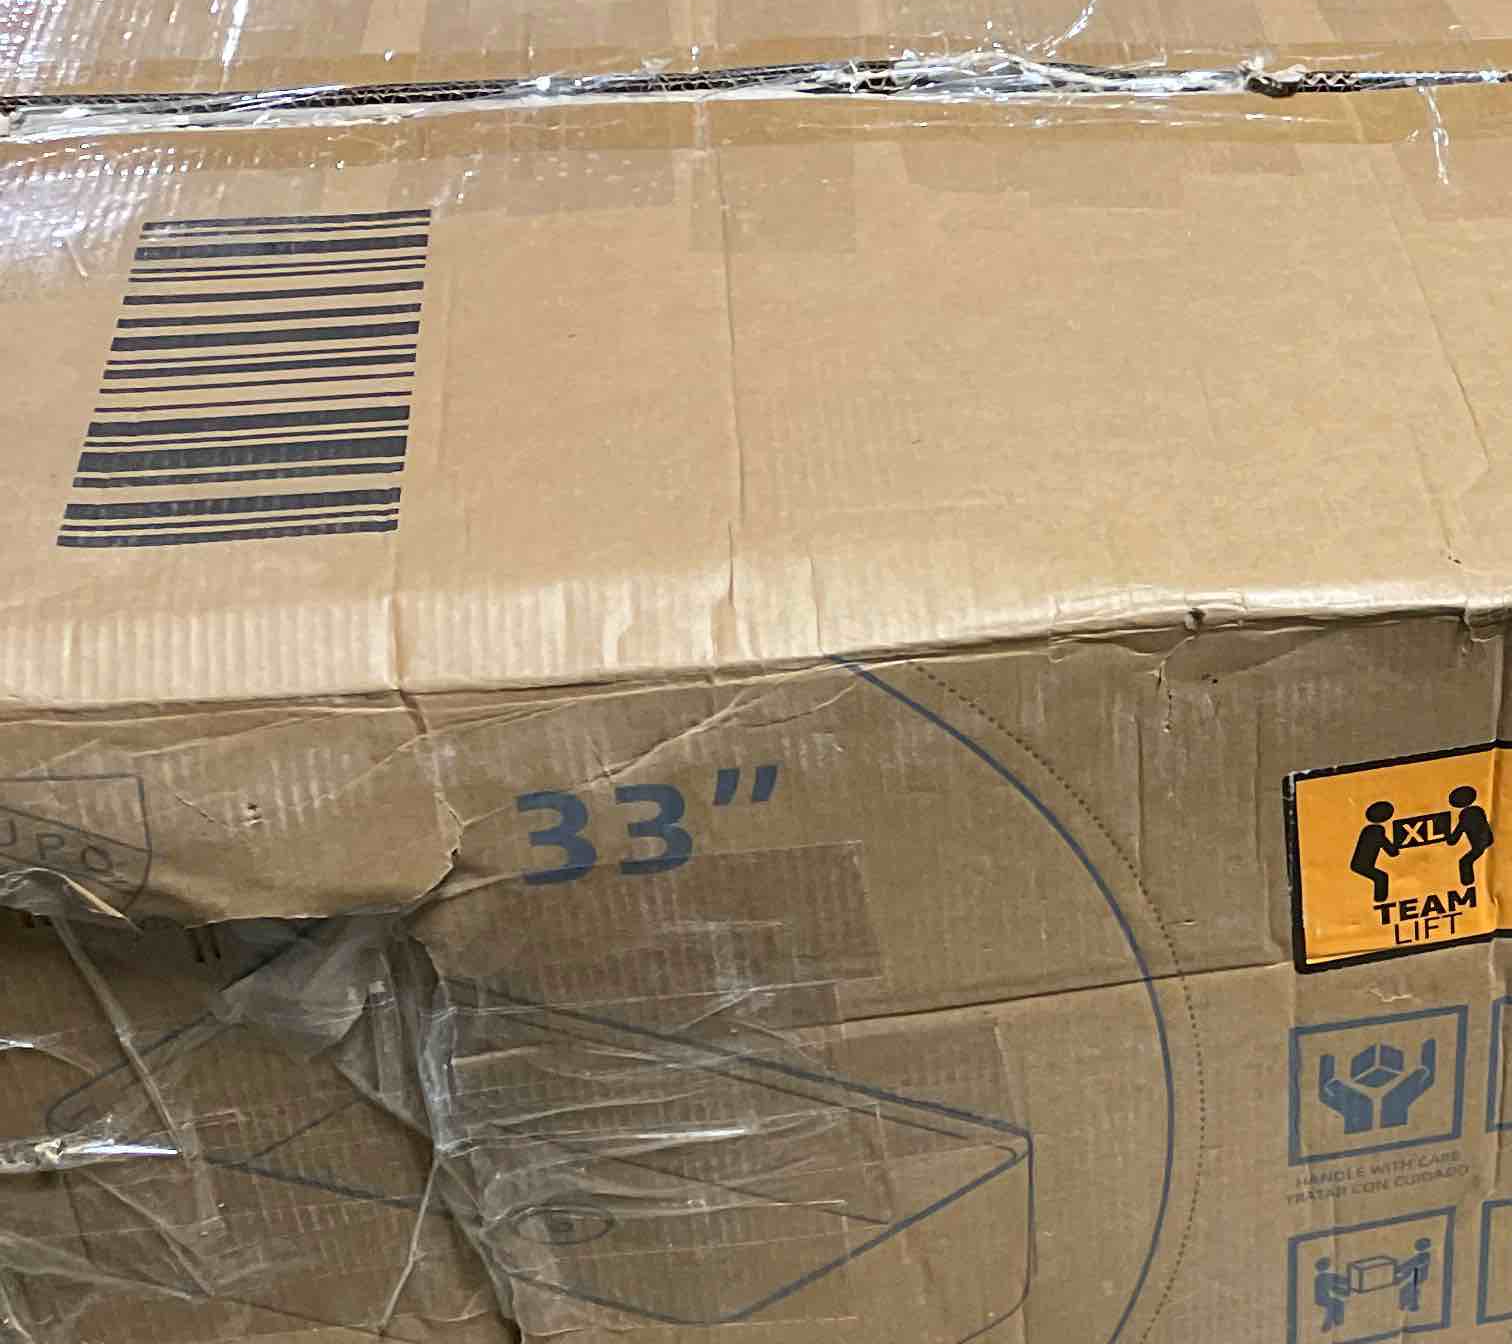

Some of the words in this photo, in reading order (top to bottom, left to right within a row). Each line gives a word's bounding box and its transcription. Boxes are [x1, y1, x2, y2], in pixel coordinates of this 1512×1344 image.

[1401, 818, 1446, 847] XL
[1373, 885, 1477, 926] TEAM
[1393, 910, 1463, 945] LIFT
[1295, 1166, 1367, 1188] HANDLE
